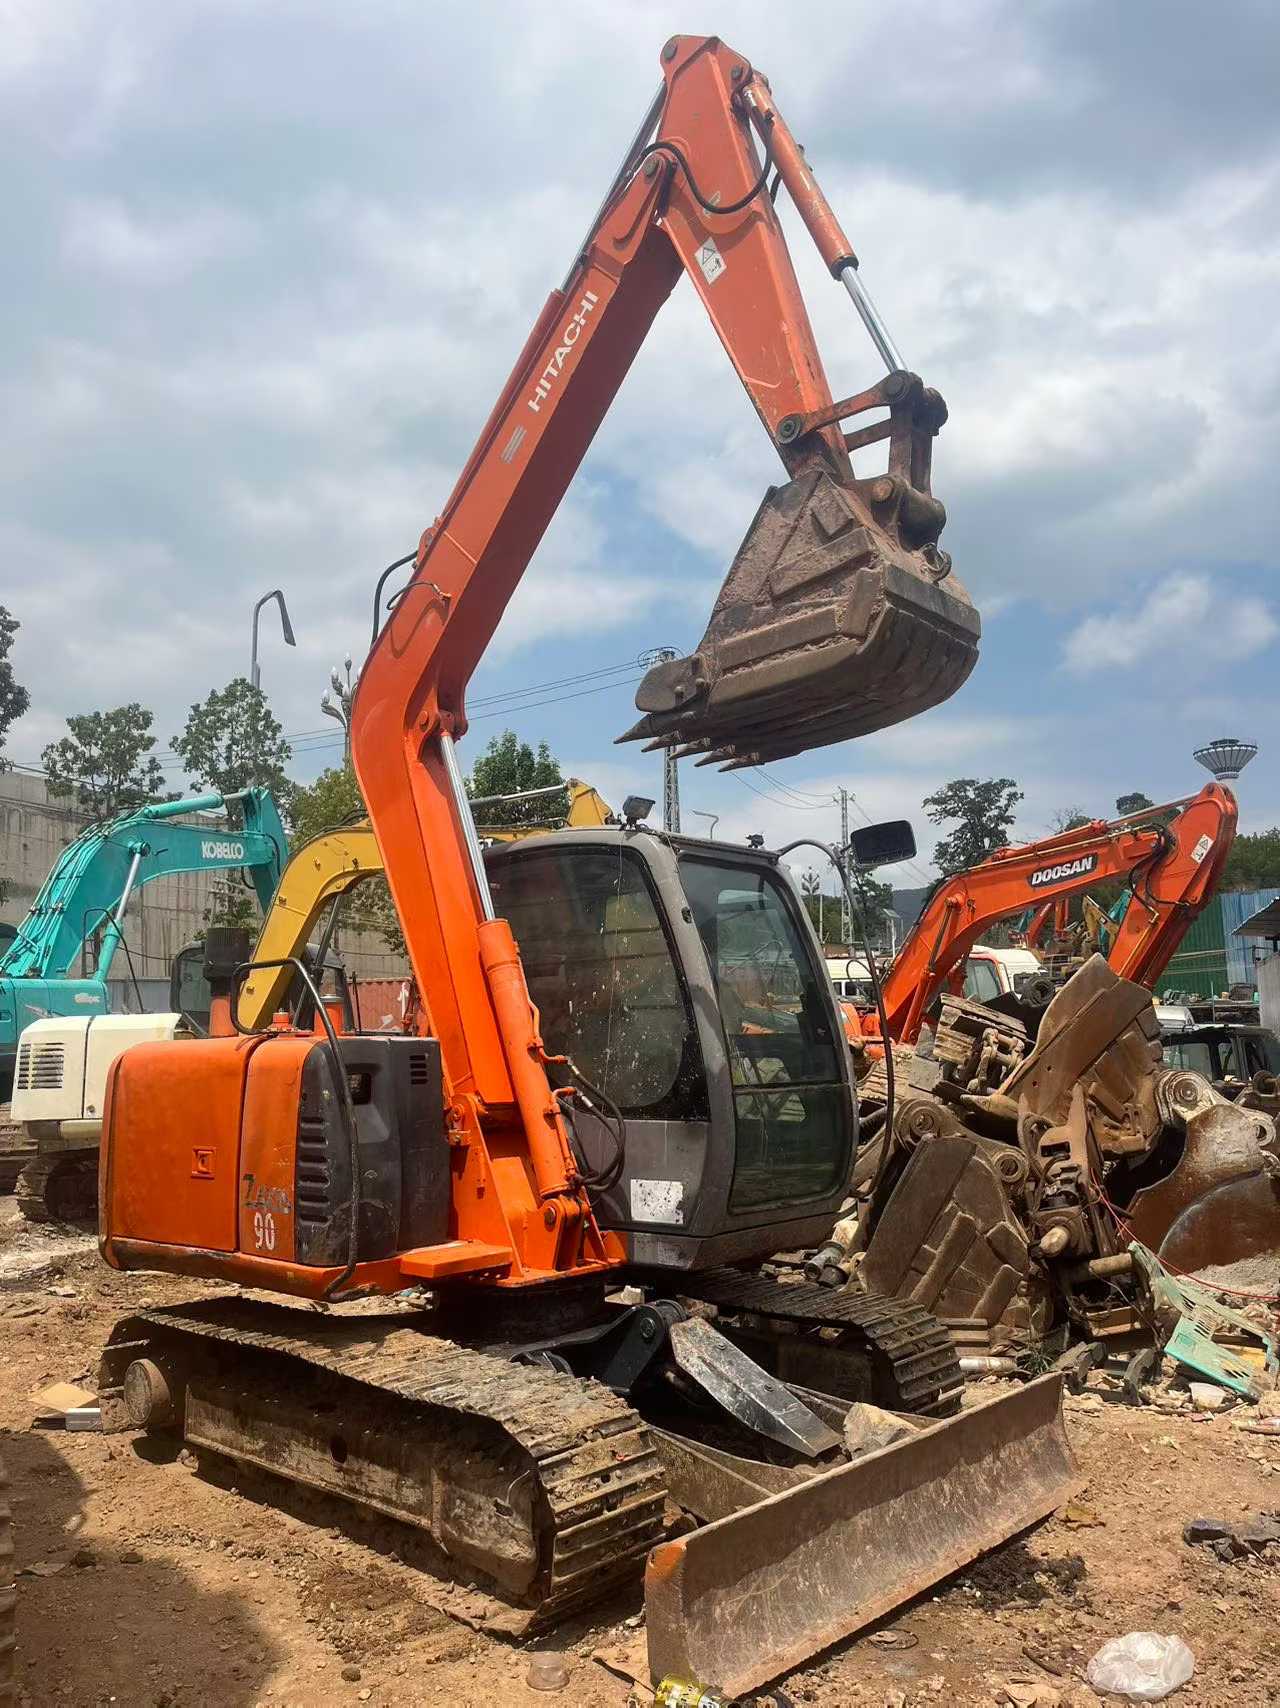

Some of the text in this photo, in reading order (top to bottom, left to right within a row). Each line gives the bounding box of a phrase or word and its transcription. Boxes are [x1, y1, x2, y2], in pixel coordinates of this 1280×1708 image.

[528, 291, 598, 412] HITACHI
[201, 841, 244, 859] KOBELCO
[1031, 856, 1093, 885] DOOSAN
[254, 1212, 275, 1250] 90
